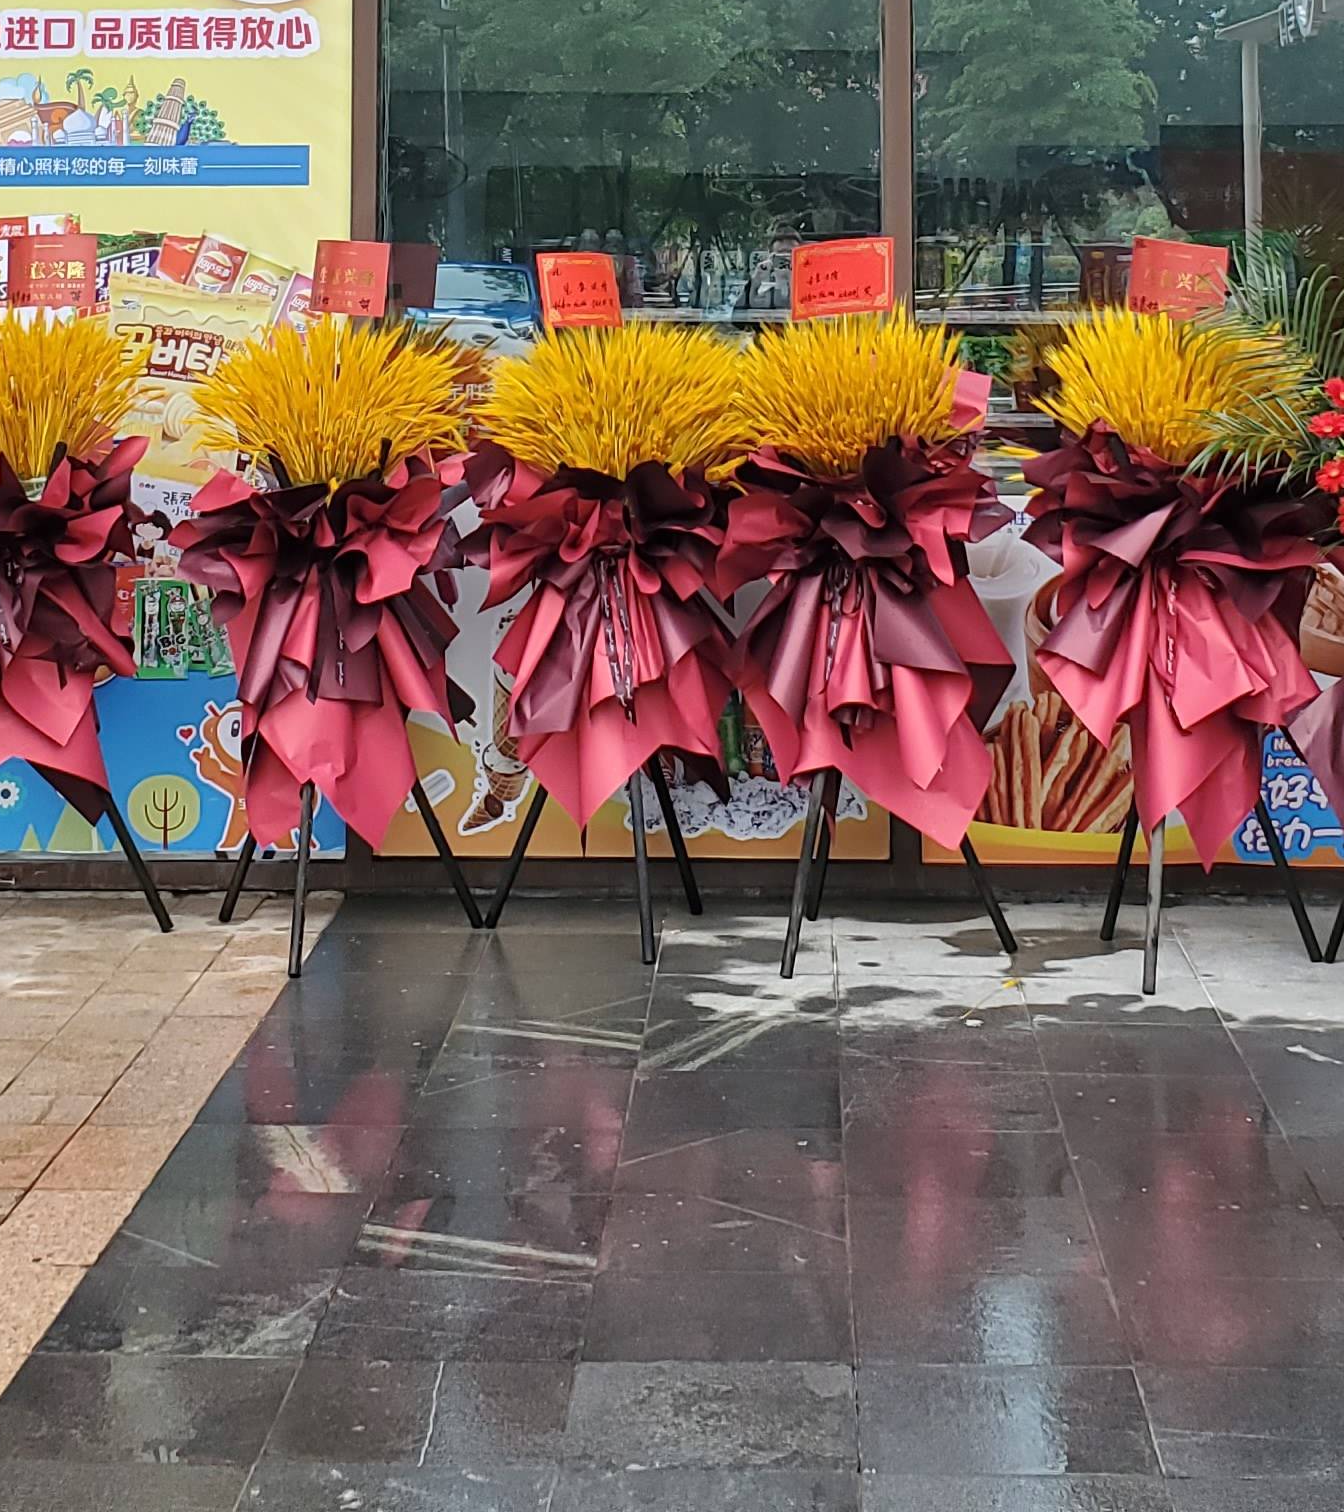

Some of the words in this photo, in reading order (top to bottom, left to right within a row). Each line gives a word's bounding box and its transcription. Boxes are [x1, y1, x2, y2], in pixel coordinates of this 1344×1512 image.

[90, 15, 313, 51] 品质值得放心
[158, 634, 187, 646] BIG
[1267, 754, 1306, 767] brea
